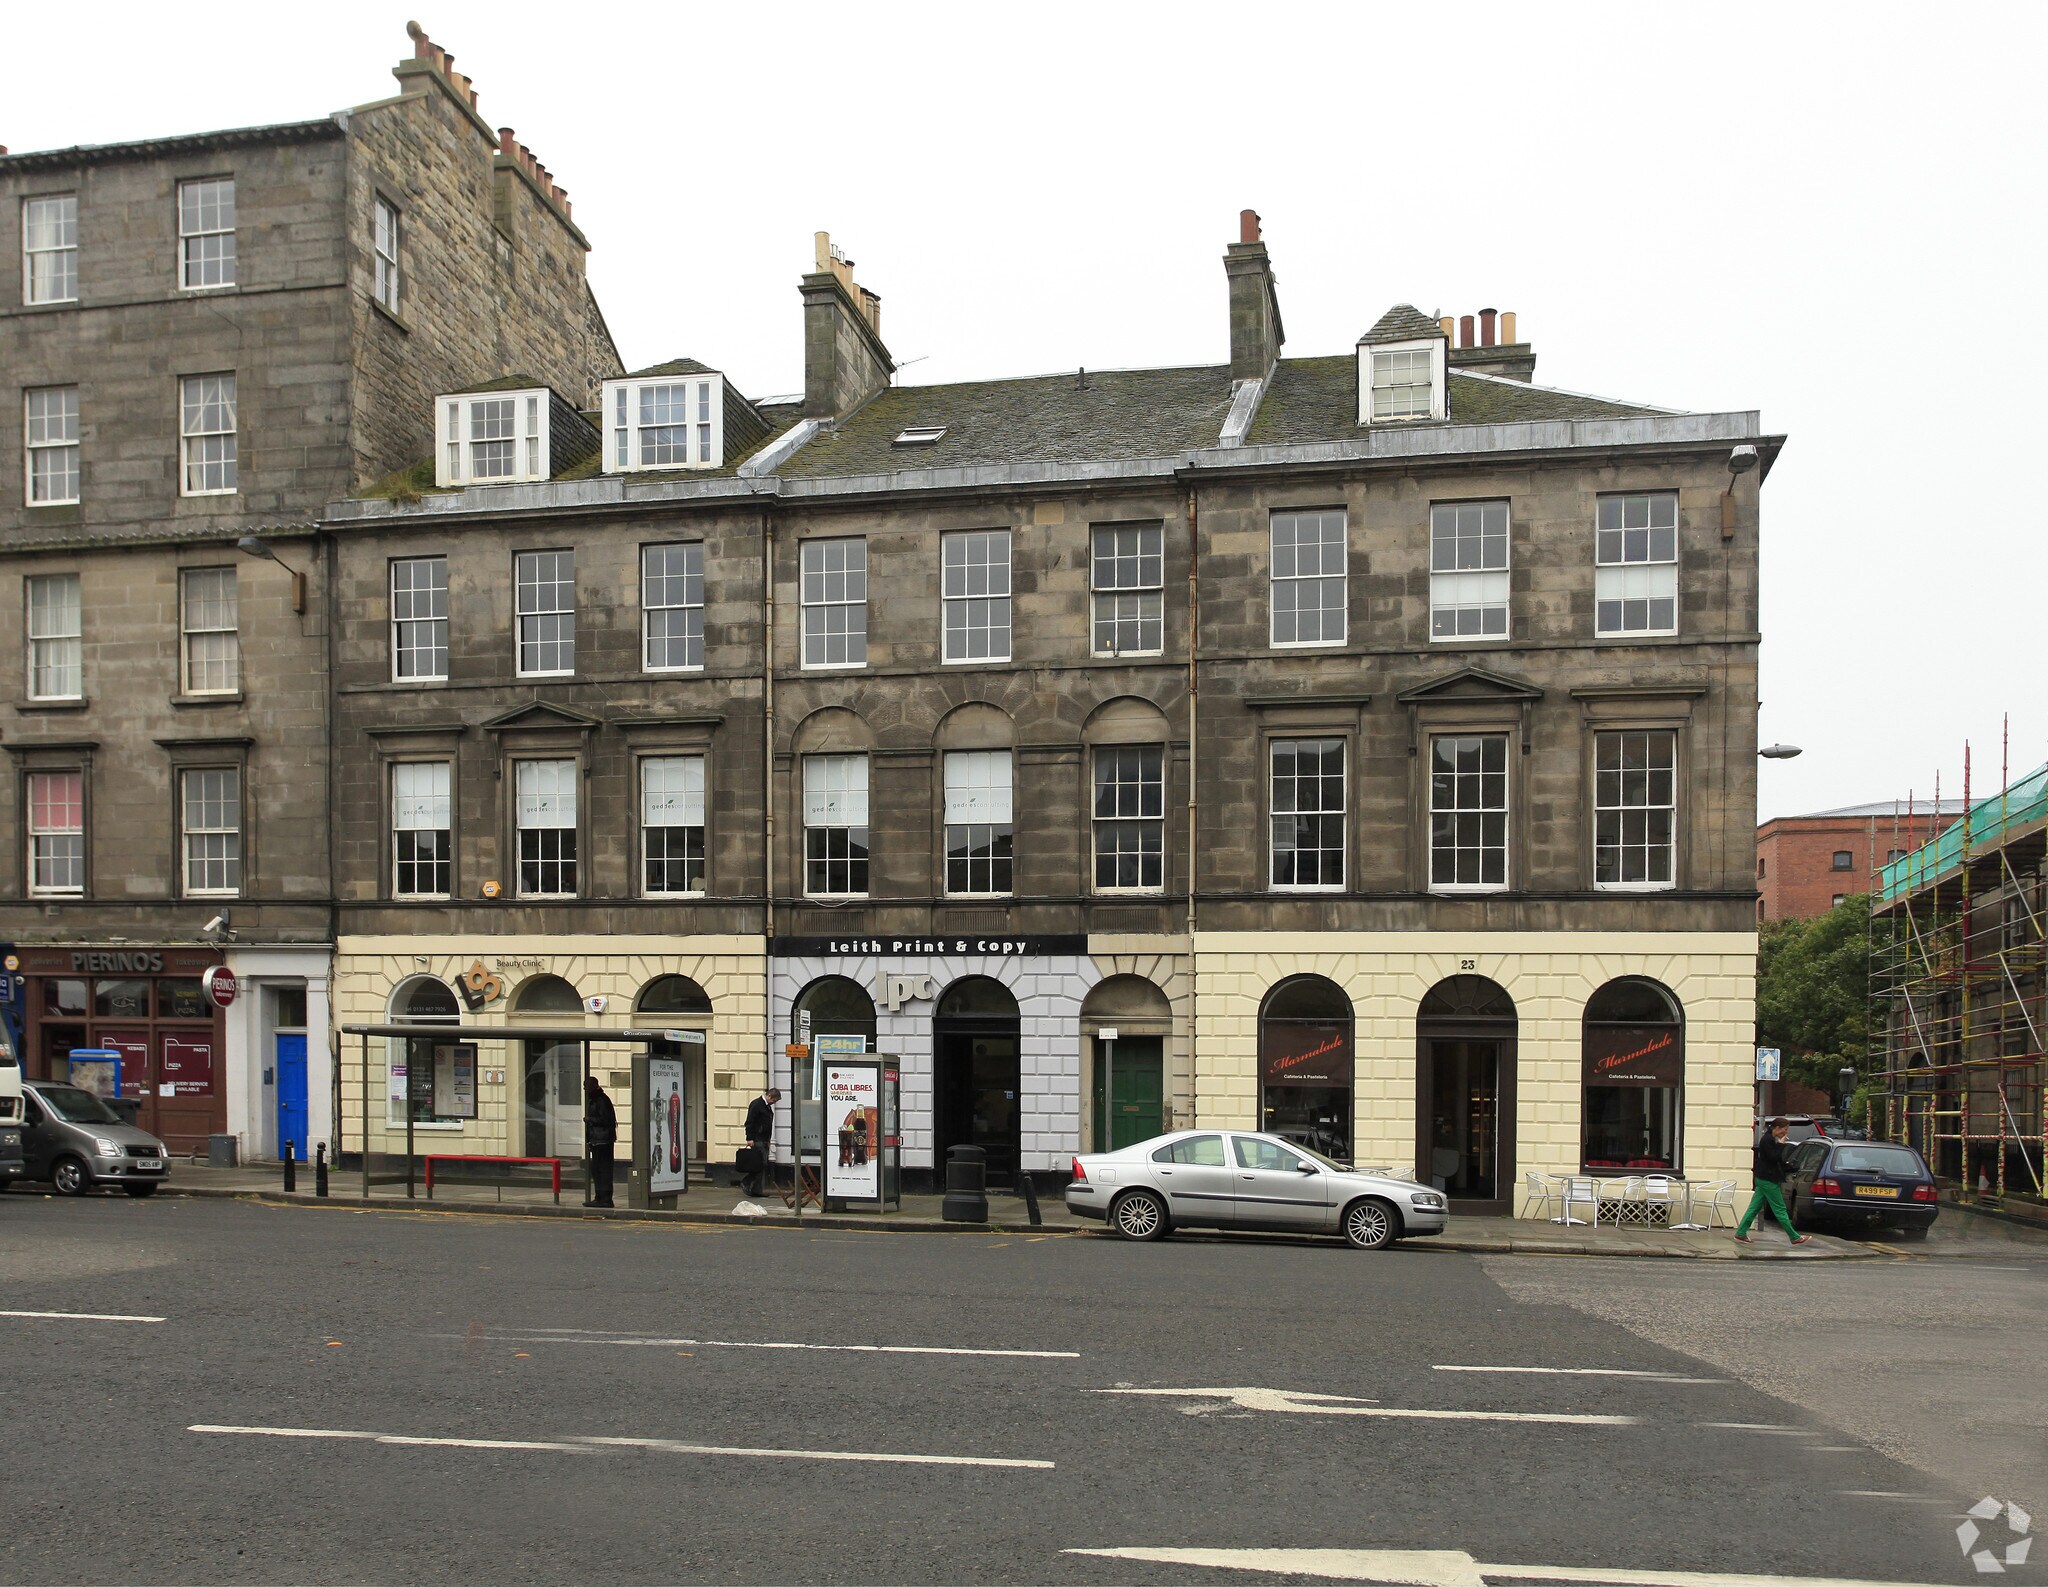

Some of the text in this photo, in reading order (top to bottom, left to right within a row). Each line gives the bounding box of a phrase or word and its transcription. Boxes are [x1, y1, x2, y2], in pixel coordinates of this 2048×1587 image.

[830, 940, 1026, 954] Leith Print & Copy
[71, 952, 163, 972] PIERINOS
[496, 959, 542, 969] Beauty Clinic
[1461, 959, 1475, 970] 23
[212, 978, 235, 991] PIERINOS
[820, 1039, 861, 1050] 24hr
[1270, 1033, 1343, 1073] Marmalade
[1593, 1032, 1673, 1073] Marmalade
[1858, 1187, 1878, 1195] R499
